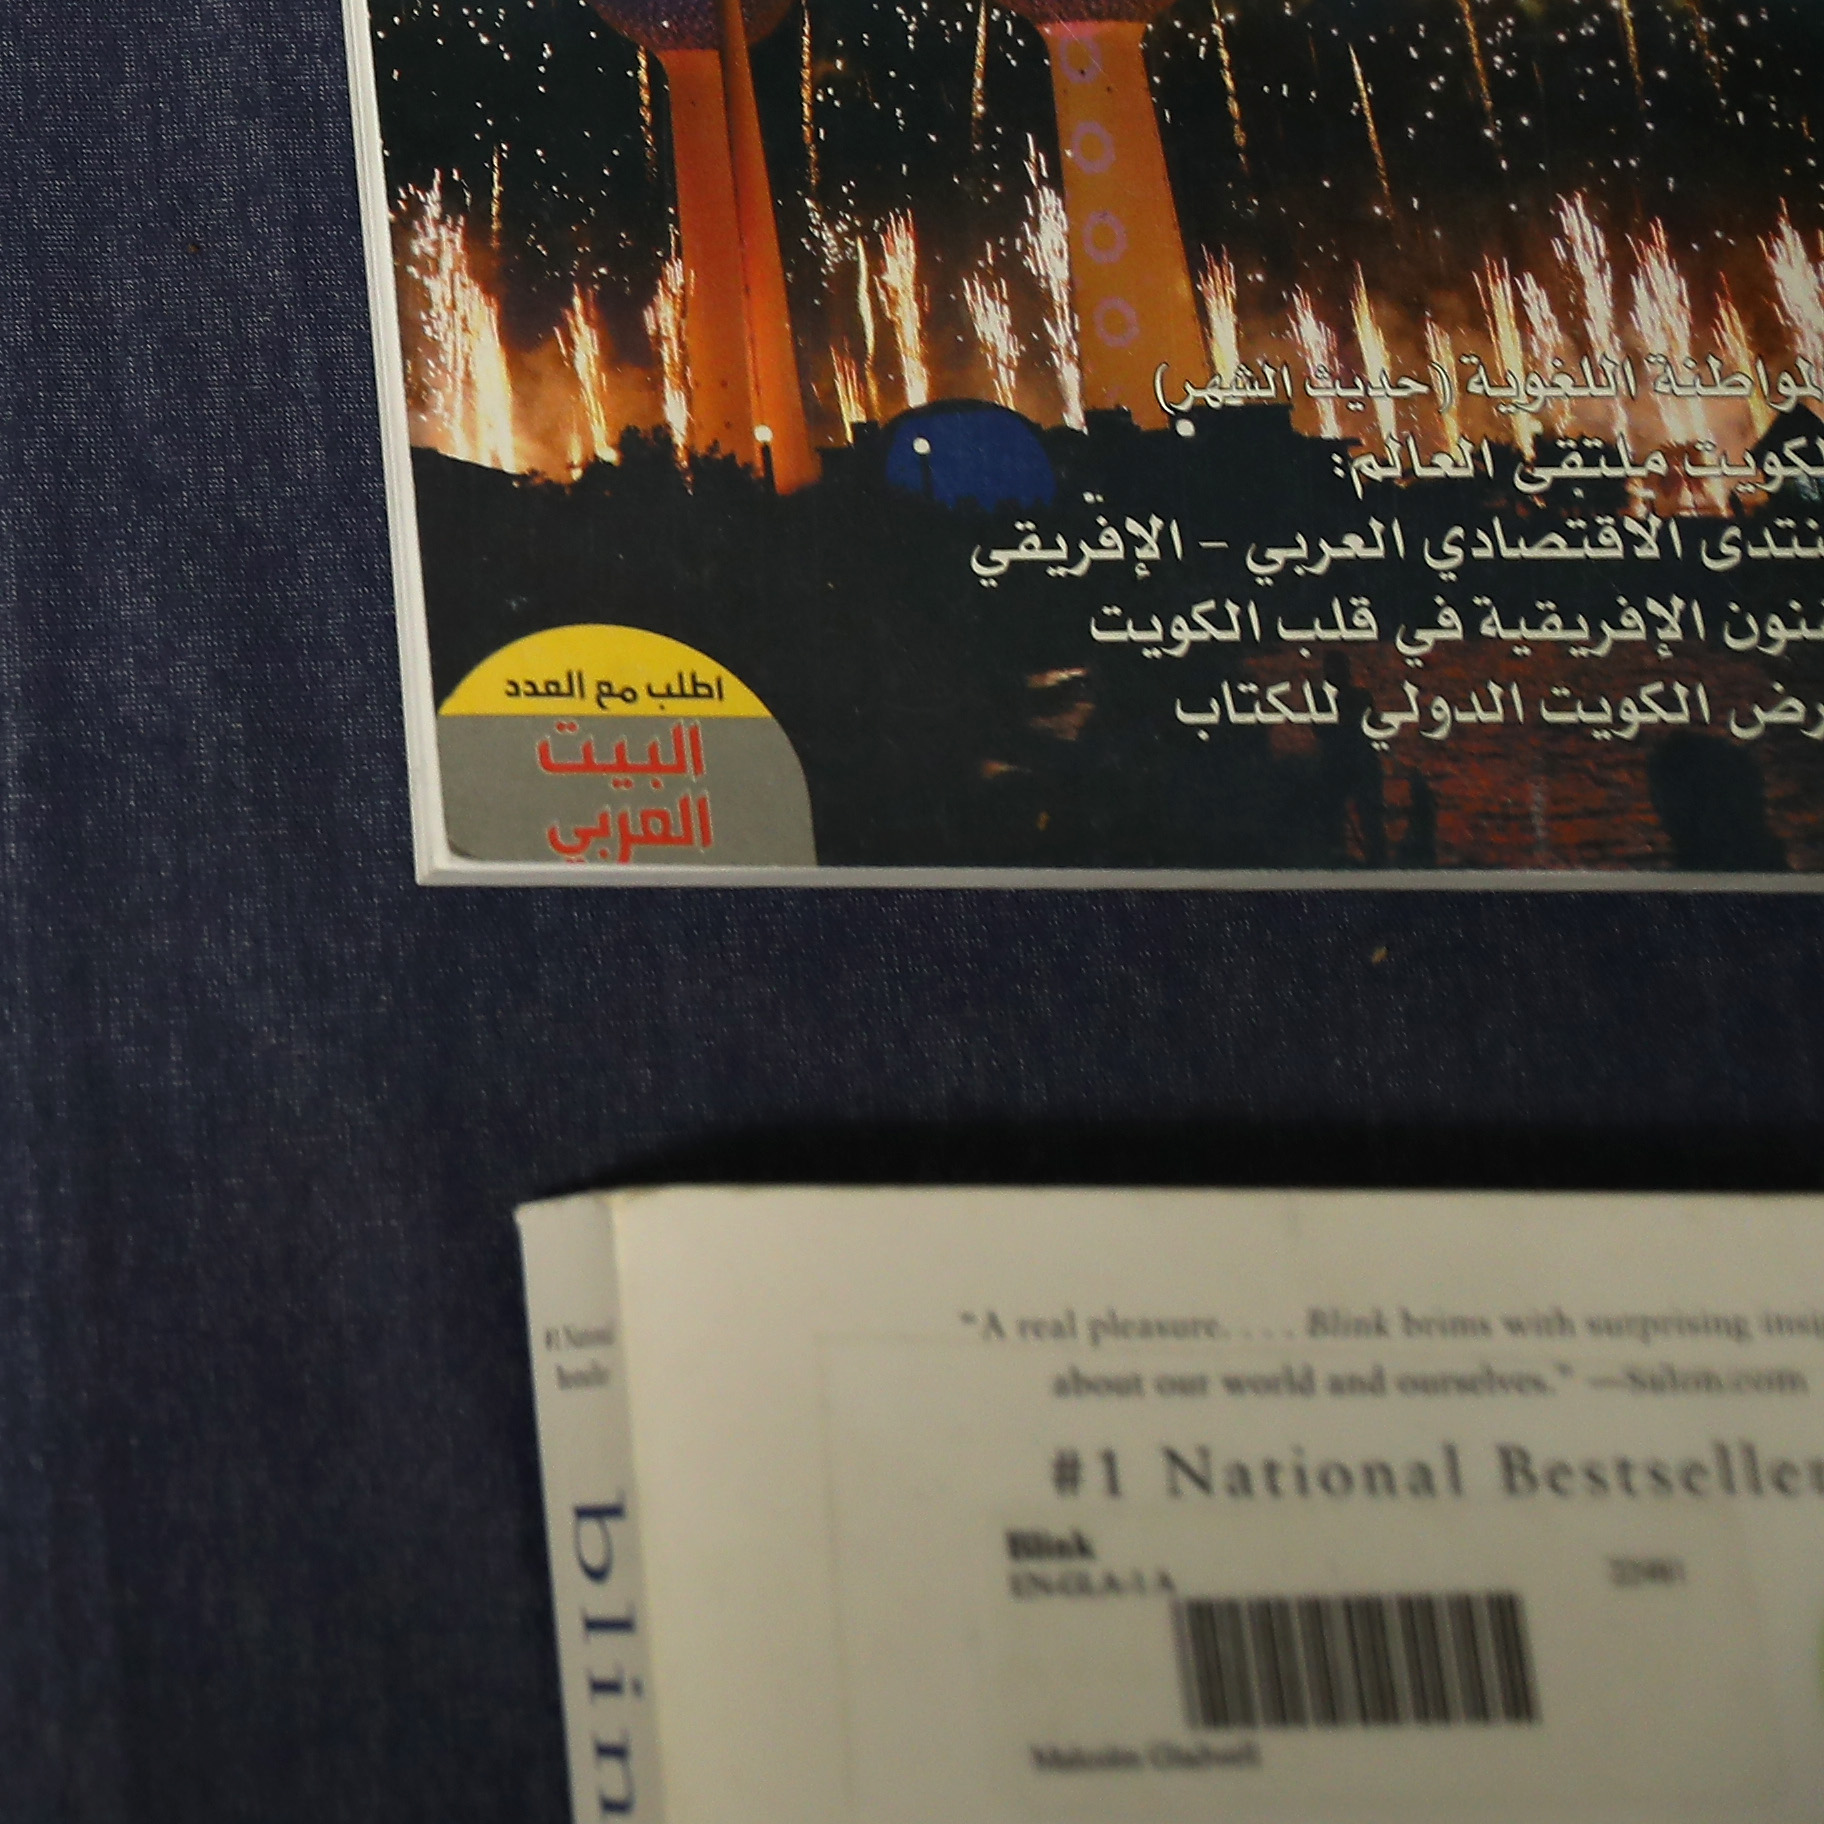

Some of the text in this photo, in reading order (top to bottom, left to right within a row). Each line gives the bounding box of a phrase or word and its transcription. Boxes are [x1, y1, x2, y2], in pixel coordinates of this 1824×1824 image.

[1463, 353, 1635, 414] اللغوية
[1514, 431, 1667, 496] ملتقى
[970, 514, 1683, 587] الاقتصادي العربي الإفريقي
[1089, 594, 1707, 666] الإفريقية في قلب الكويت
[505, 670, 725, 710] اطلب مع العدد
[1174, 680, 1710, 752] الكويت الدولي للكتاب
[537, 719, 705, 791] البيت
[547, 791, 713, 864] العربي
[1017, 1308, 1076, 1340] real
[1306, 1307, 1389, 1340] Blink
[1401, 1308, 1490, 1340] brims
[1501, 1308, 1573, 1338] with
[1054, 1364, 1386, 1399] about our world and
[1052, 1446, 1124, 1501] #1
[1163, 1441, 1465, 1502] National
[1006, 1528, 1095, 1563] Blink
